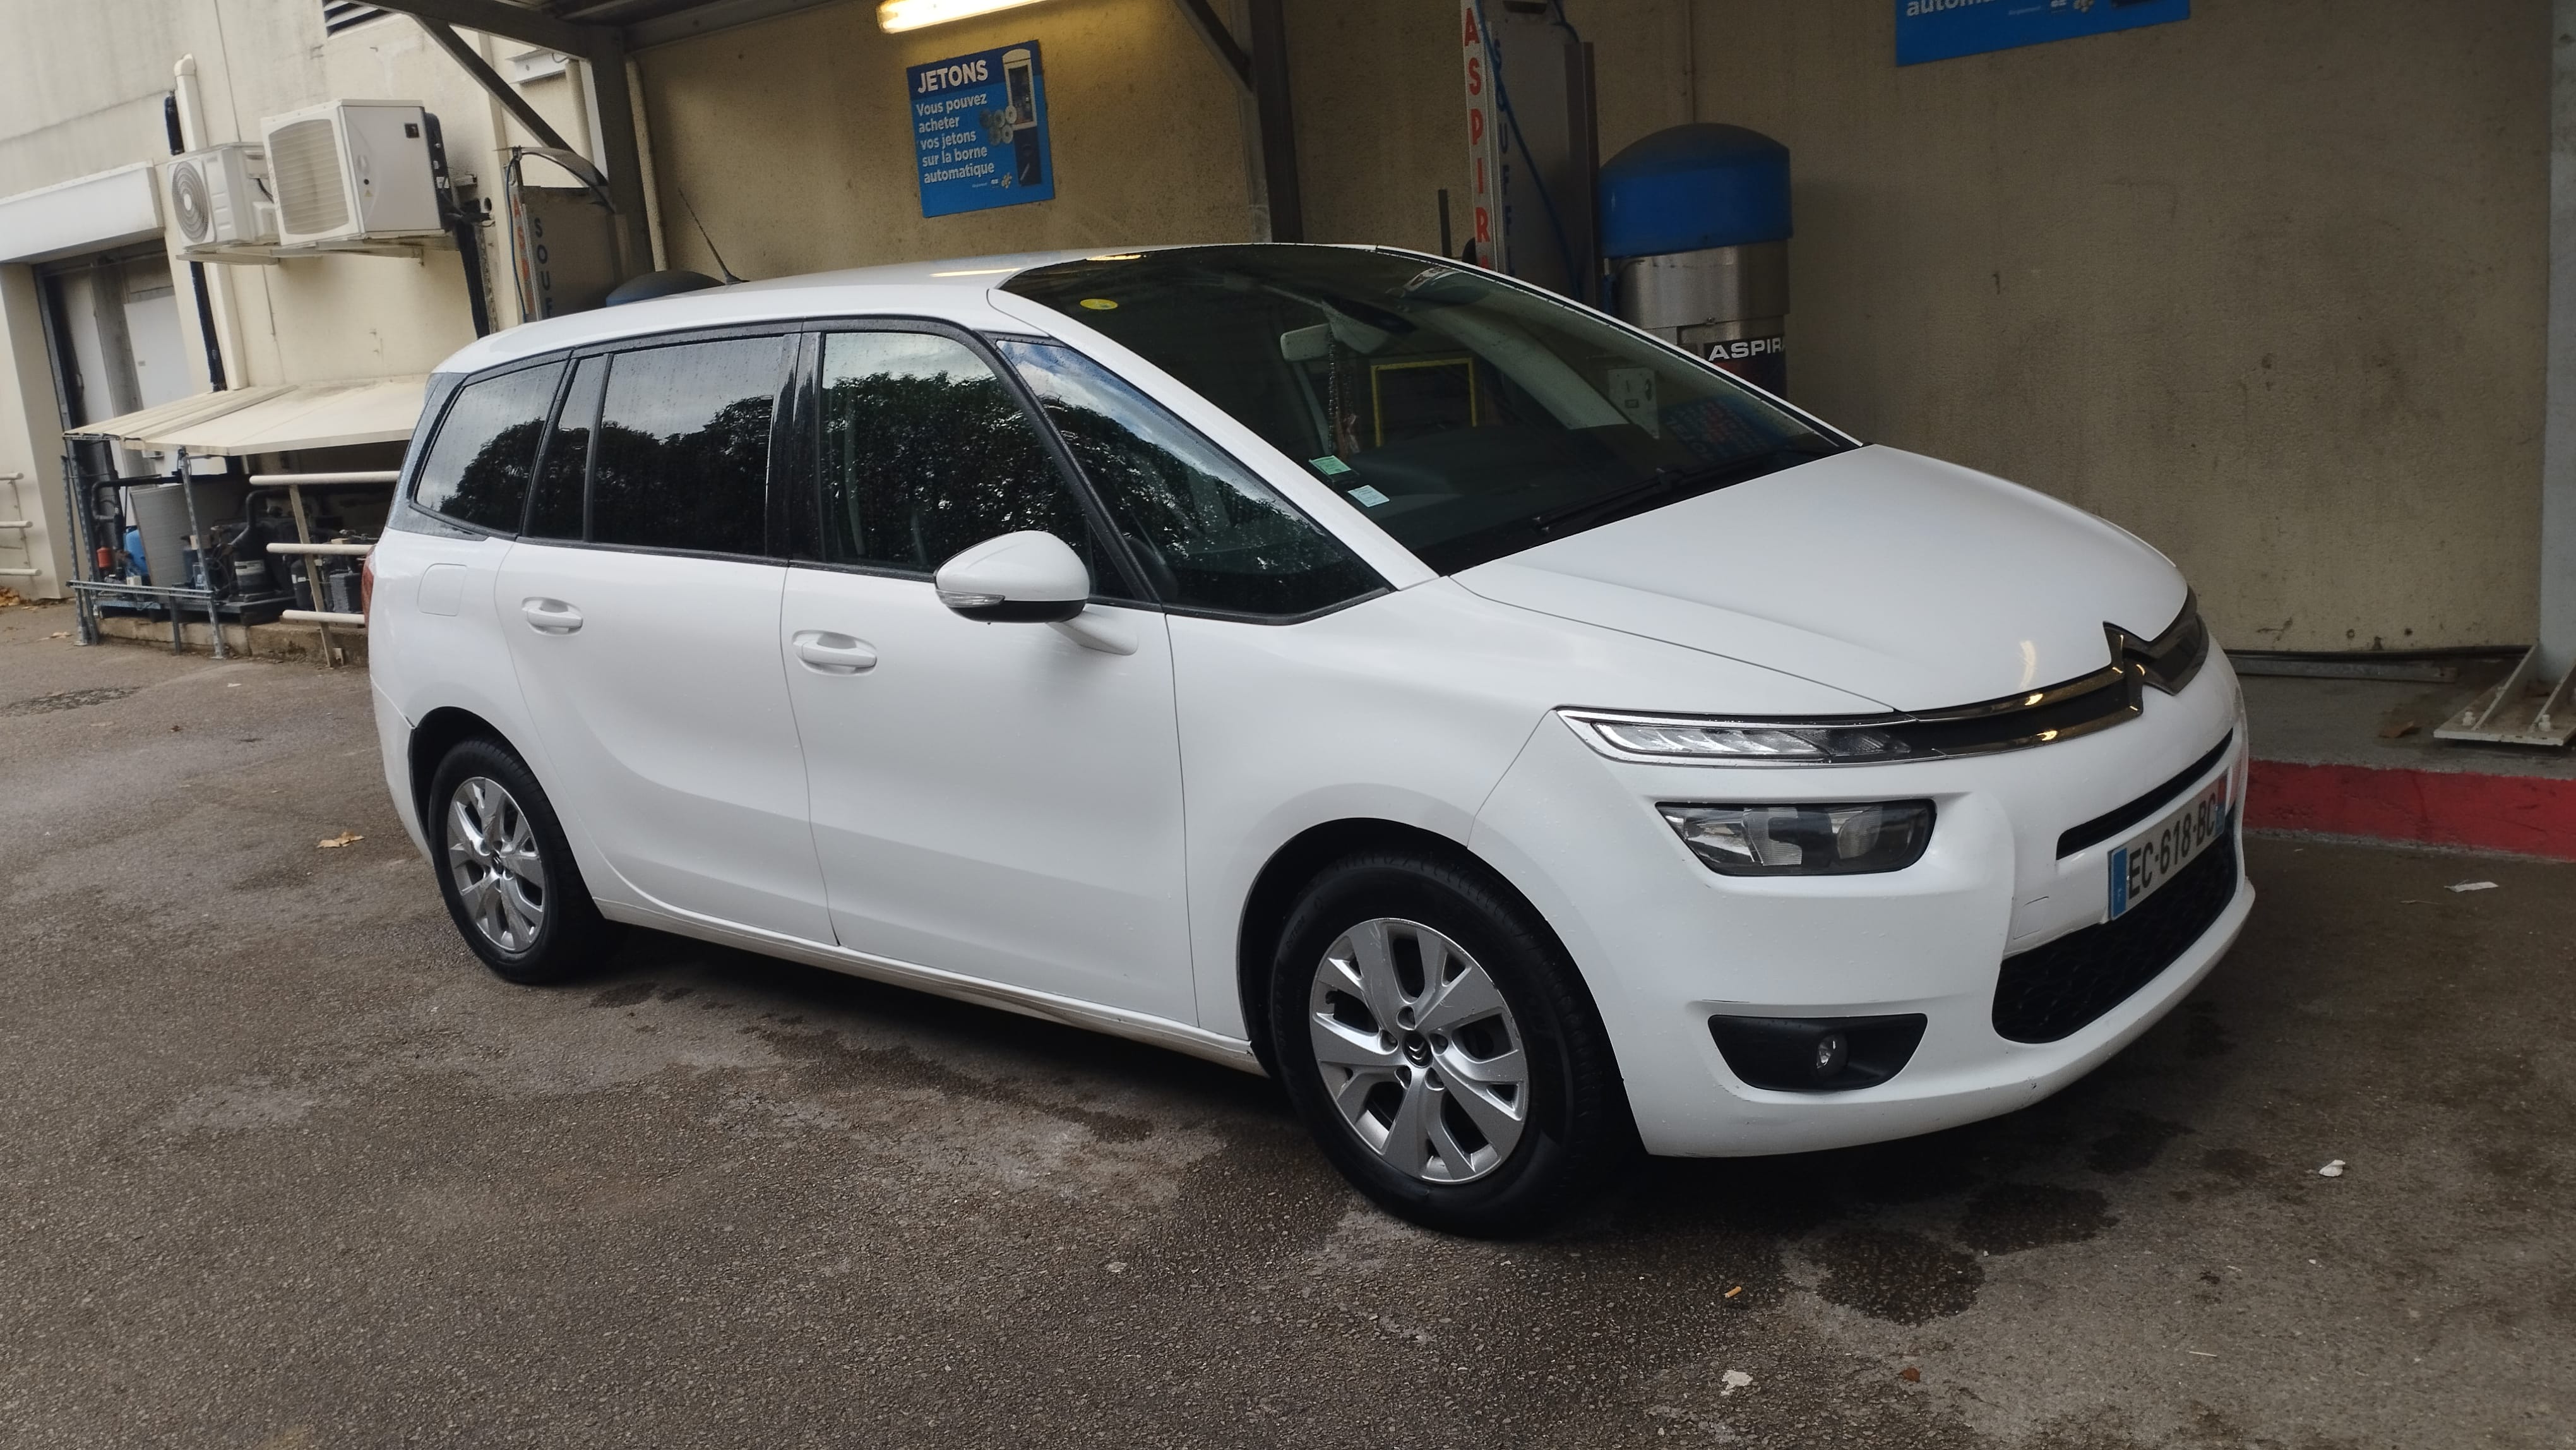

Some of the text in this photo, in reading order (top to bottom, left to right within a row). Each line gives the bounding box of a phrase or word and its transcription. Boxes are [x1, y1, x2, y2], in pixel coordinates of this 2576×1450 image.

[918, 59, 988, 93] JETONS
[916, 93, 987, 116] Vous pouvez
[919, 116, 960, 133] acheter
[920, 130, 977, 150] vos jetons
[922, 146, 988, 167] sur la borne
[924, 162, 995, 183] automatique
[1708, 337, 1786, 361] ASPIR
[2128, 792, 2217, 900] EC-618-BC
